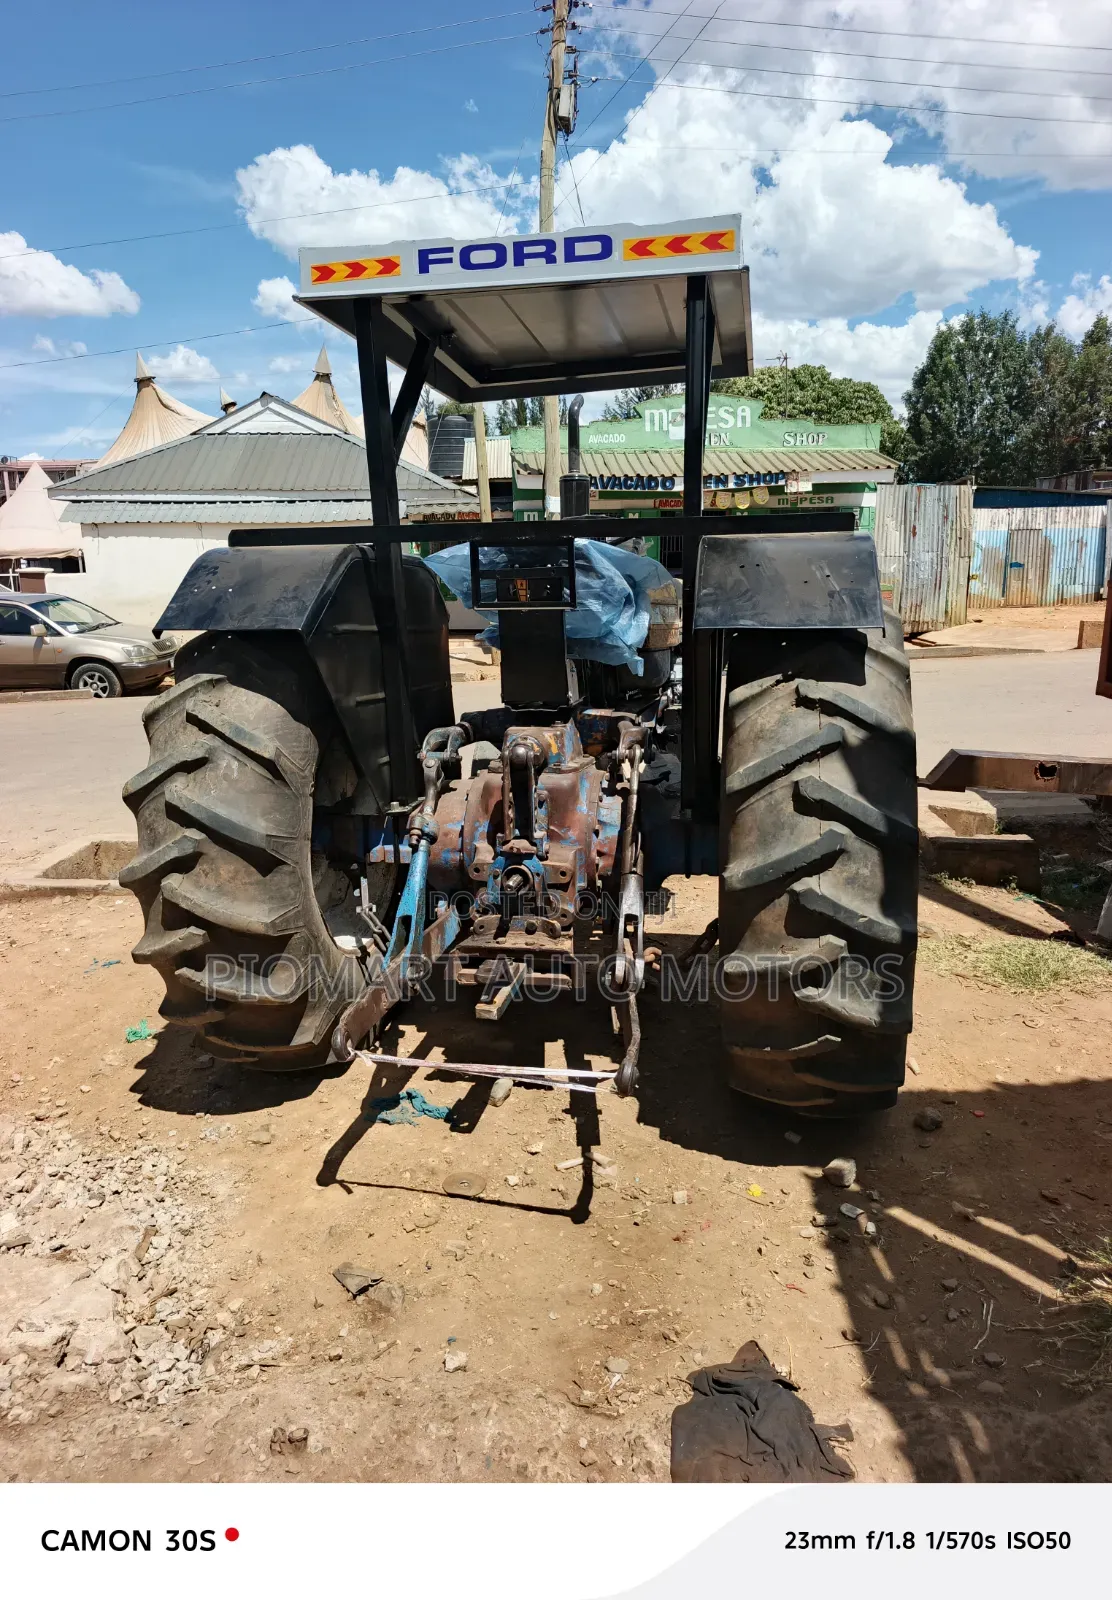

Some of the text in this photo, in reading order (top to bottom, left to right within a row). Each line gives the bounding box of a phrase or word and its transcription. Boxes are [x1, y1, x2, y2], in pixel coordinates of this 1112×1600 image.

[417, 234, 613, 275] FORD
[588, 433, 626, 444] AVACADO
[782, 431, 828, 447] SHOP
[590, 475, 676, 491] AVACADO
[733, 471, 786, 488] SHOP
